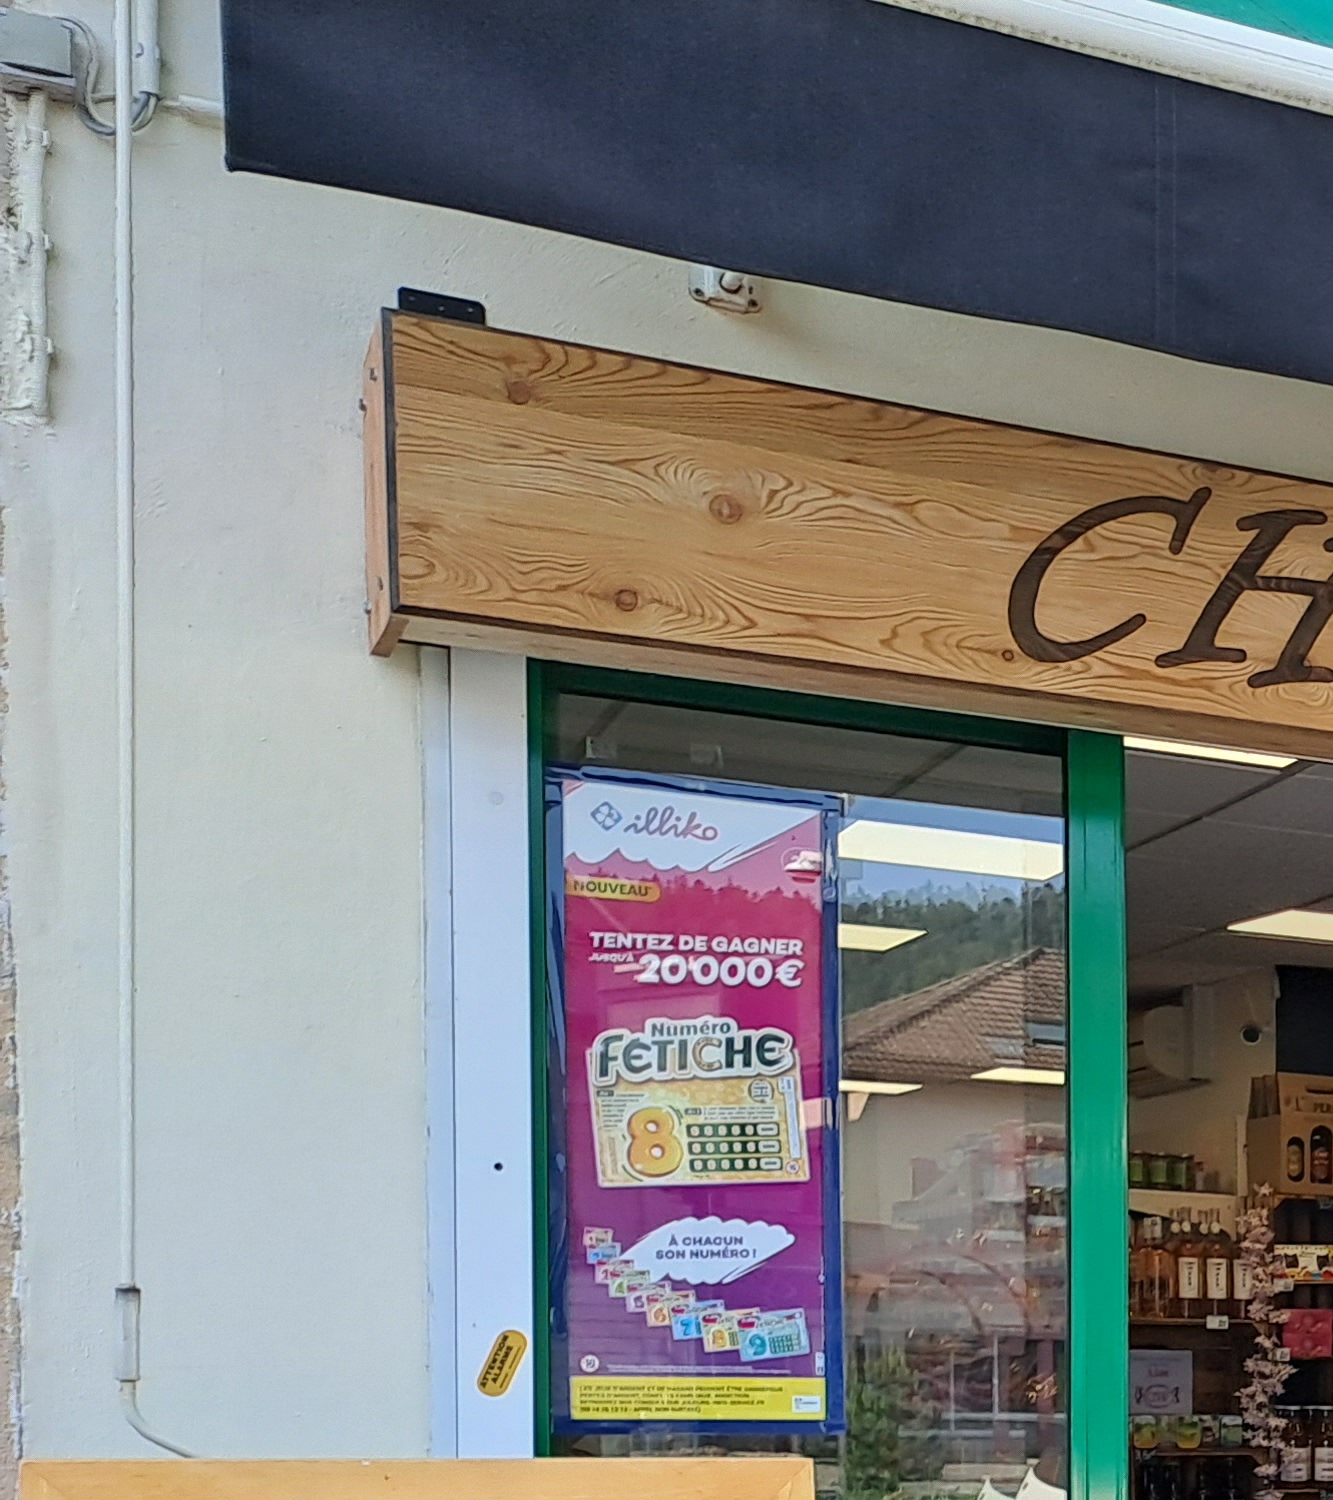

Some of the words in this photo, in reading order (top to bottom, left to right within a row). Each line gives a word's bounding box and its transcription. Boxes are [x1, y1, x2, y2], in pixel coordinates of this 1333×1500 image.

[624, 806, 718, 841] illiko
[589, 932, 674, 950] TENTEZ
[678, 936, 708, 951] DE
[711, 938, 803, 955] GAGNER
[651, 1021, 731, 1037] Numéro
[627, 1106, 683, 1177] 8
[656, 1249, 685, 1259] SON
